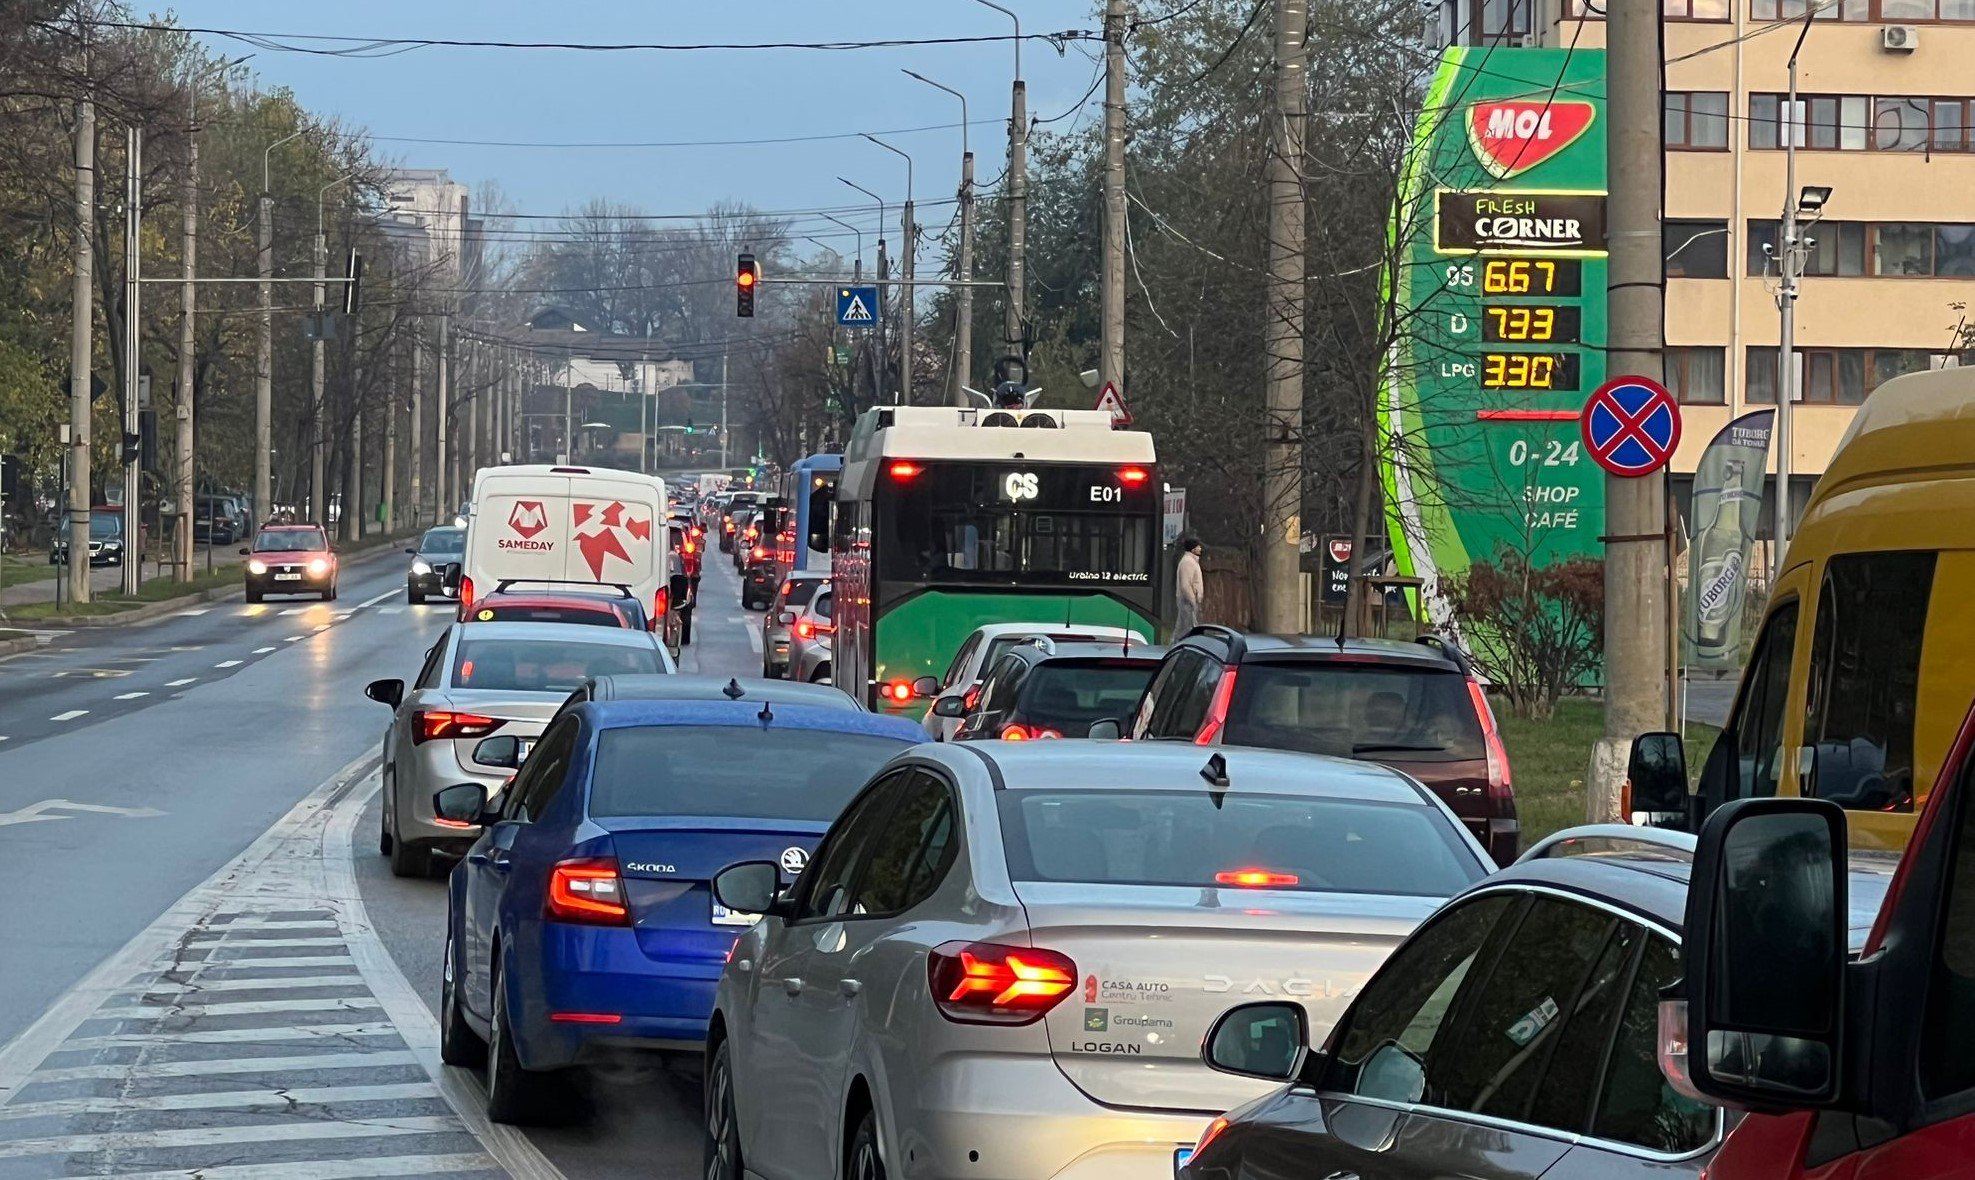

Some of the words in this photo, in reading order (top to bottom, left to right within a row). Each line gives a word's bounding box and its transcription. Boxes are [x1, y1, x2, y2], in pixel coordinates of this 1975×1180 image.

[1485, 108, 1553, 140] MOL
[1476, 199, 1535, 214] FRESH
[1446, 266, 1474, 286] 95
[1451, 313, 1468, 333] D
[1441, 363, 1475, 377] LPG
[1090, 485, 1121, 502] E01
[1522, 486, 1579, 502] SHOP
[1524, 509, 1579, 528] CAFÉ
[498, 539, 554, 551] SAMEDAY
[1101, 571, 1112, 580] 12
[1113, 572, 1148, 581] electric
[1102, 980, 1133, 990] CASA
[1136, 983, 1169, 992] AUTO
[1113, 1015, 1173, 1028] Groupama
[1072, 1041, 1141, 1054] LOGAN
